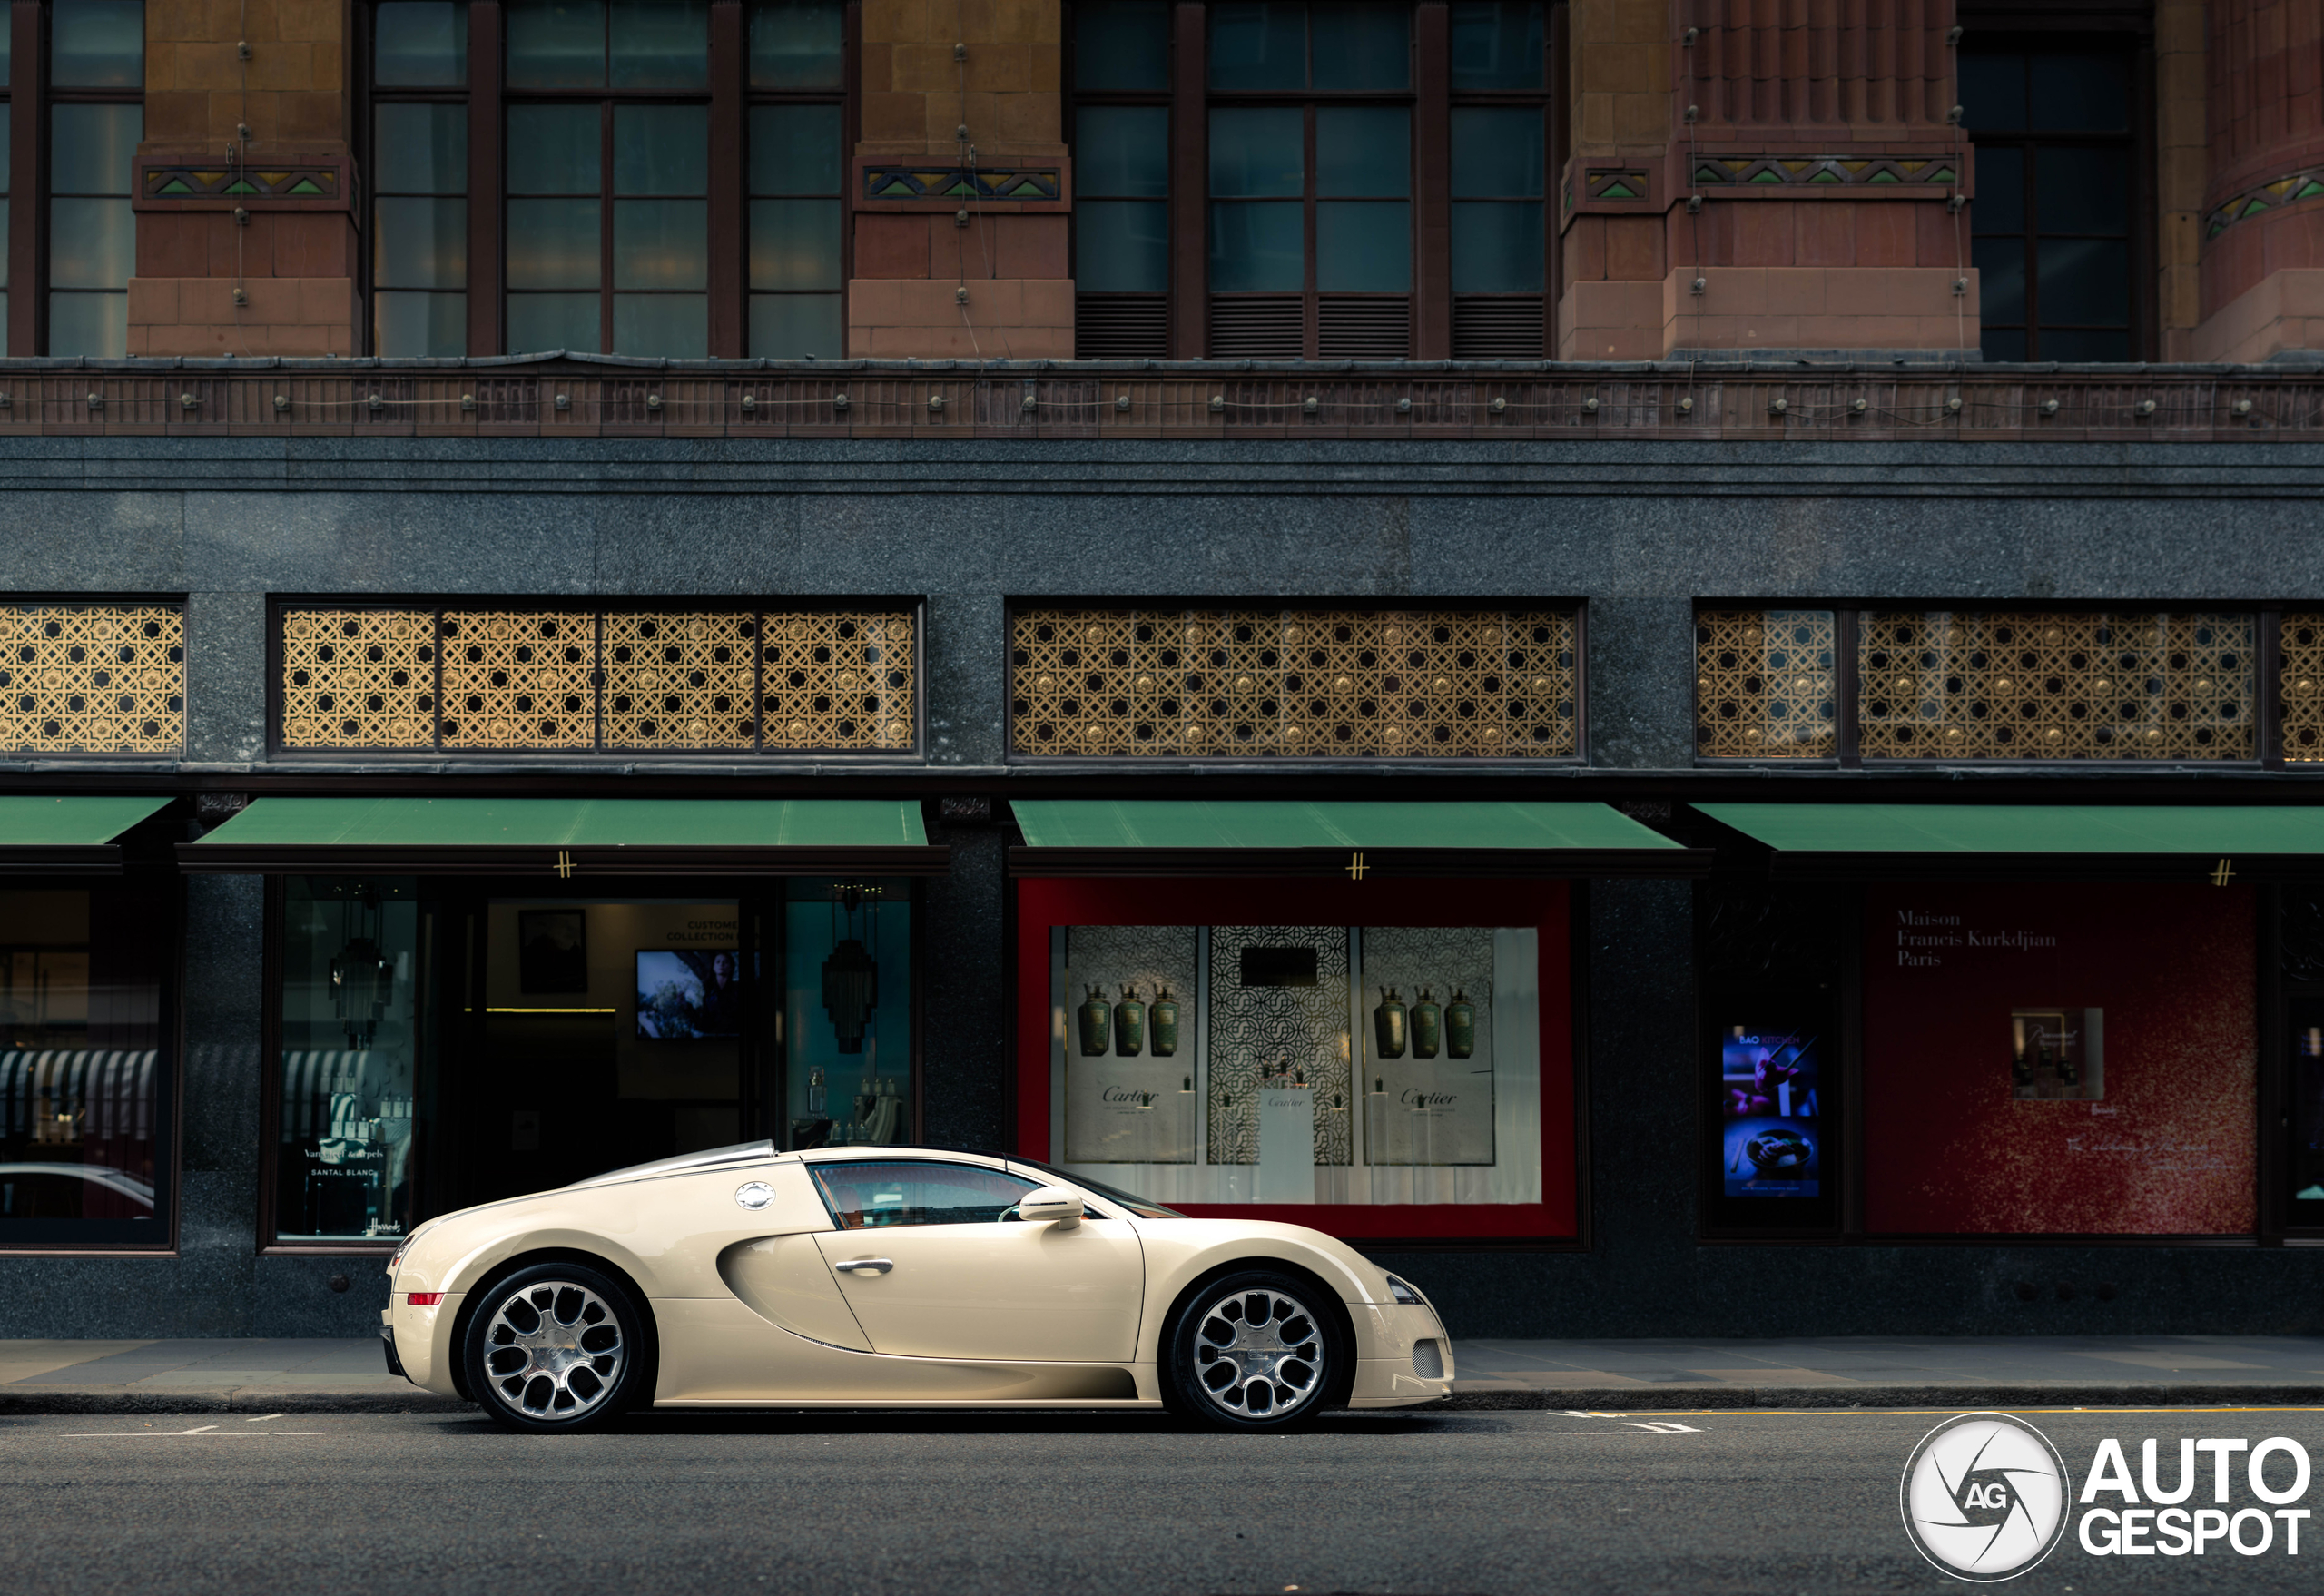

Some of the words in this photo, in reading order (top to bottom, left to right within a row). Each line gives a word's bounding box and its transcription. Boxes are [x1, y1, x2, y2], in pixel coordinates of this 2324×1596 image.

[1897, 910, 1961, 926] Maison
[687, 921, 739, 930] CUSTOME
[666, 932, 734, 941] COLLECTION
[1897, 929, 1964, 947] Francis
[1967, 930, 2057, 952] Kurkdjian
[1897, 950, 1942, 967] Paris
[1738, 1035, 1760, 1045] BAO
[1761, 1035, 1800, 1045] KITCHEN
[1102, 1085, 1159, 1102] Cartir
[1268, 1096, 1305, 1108] Cartier
[304, 1148, 320, 1158] Van
[310, 1168, 343, 1177] SANTAL
[346, 1168, 374, 1177] BLANC
[368, 1217, 401, 1235] Harrods
